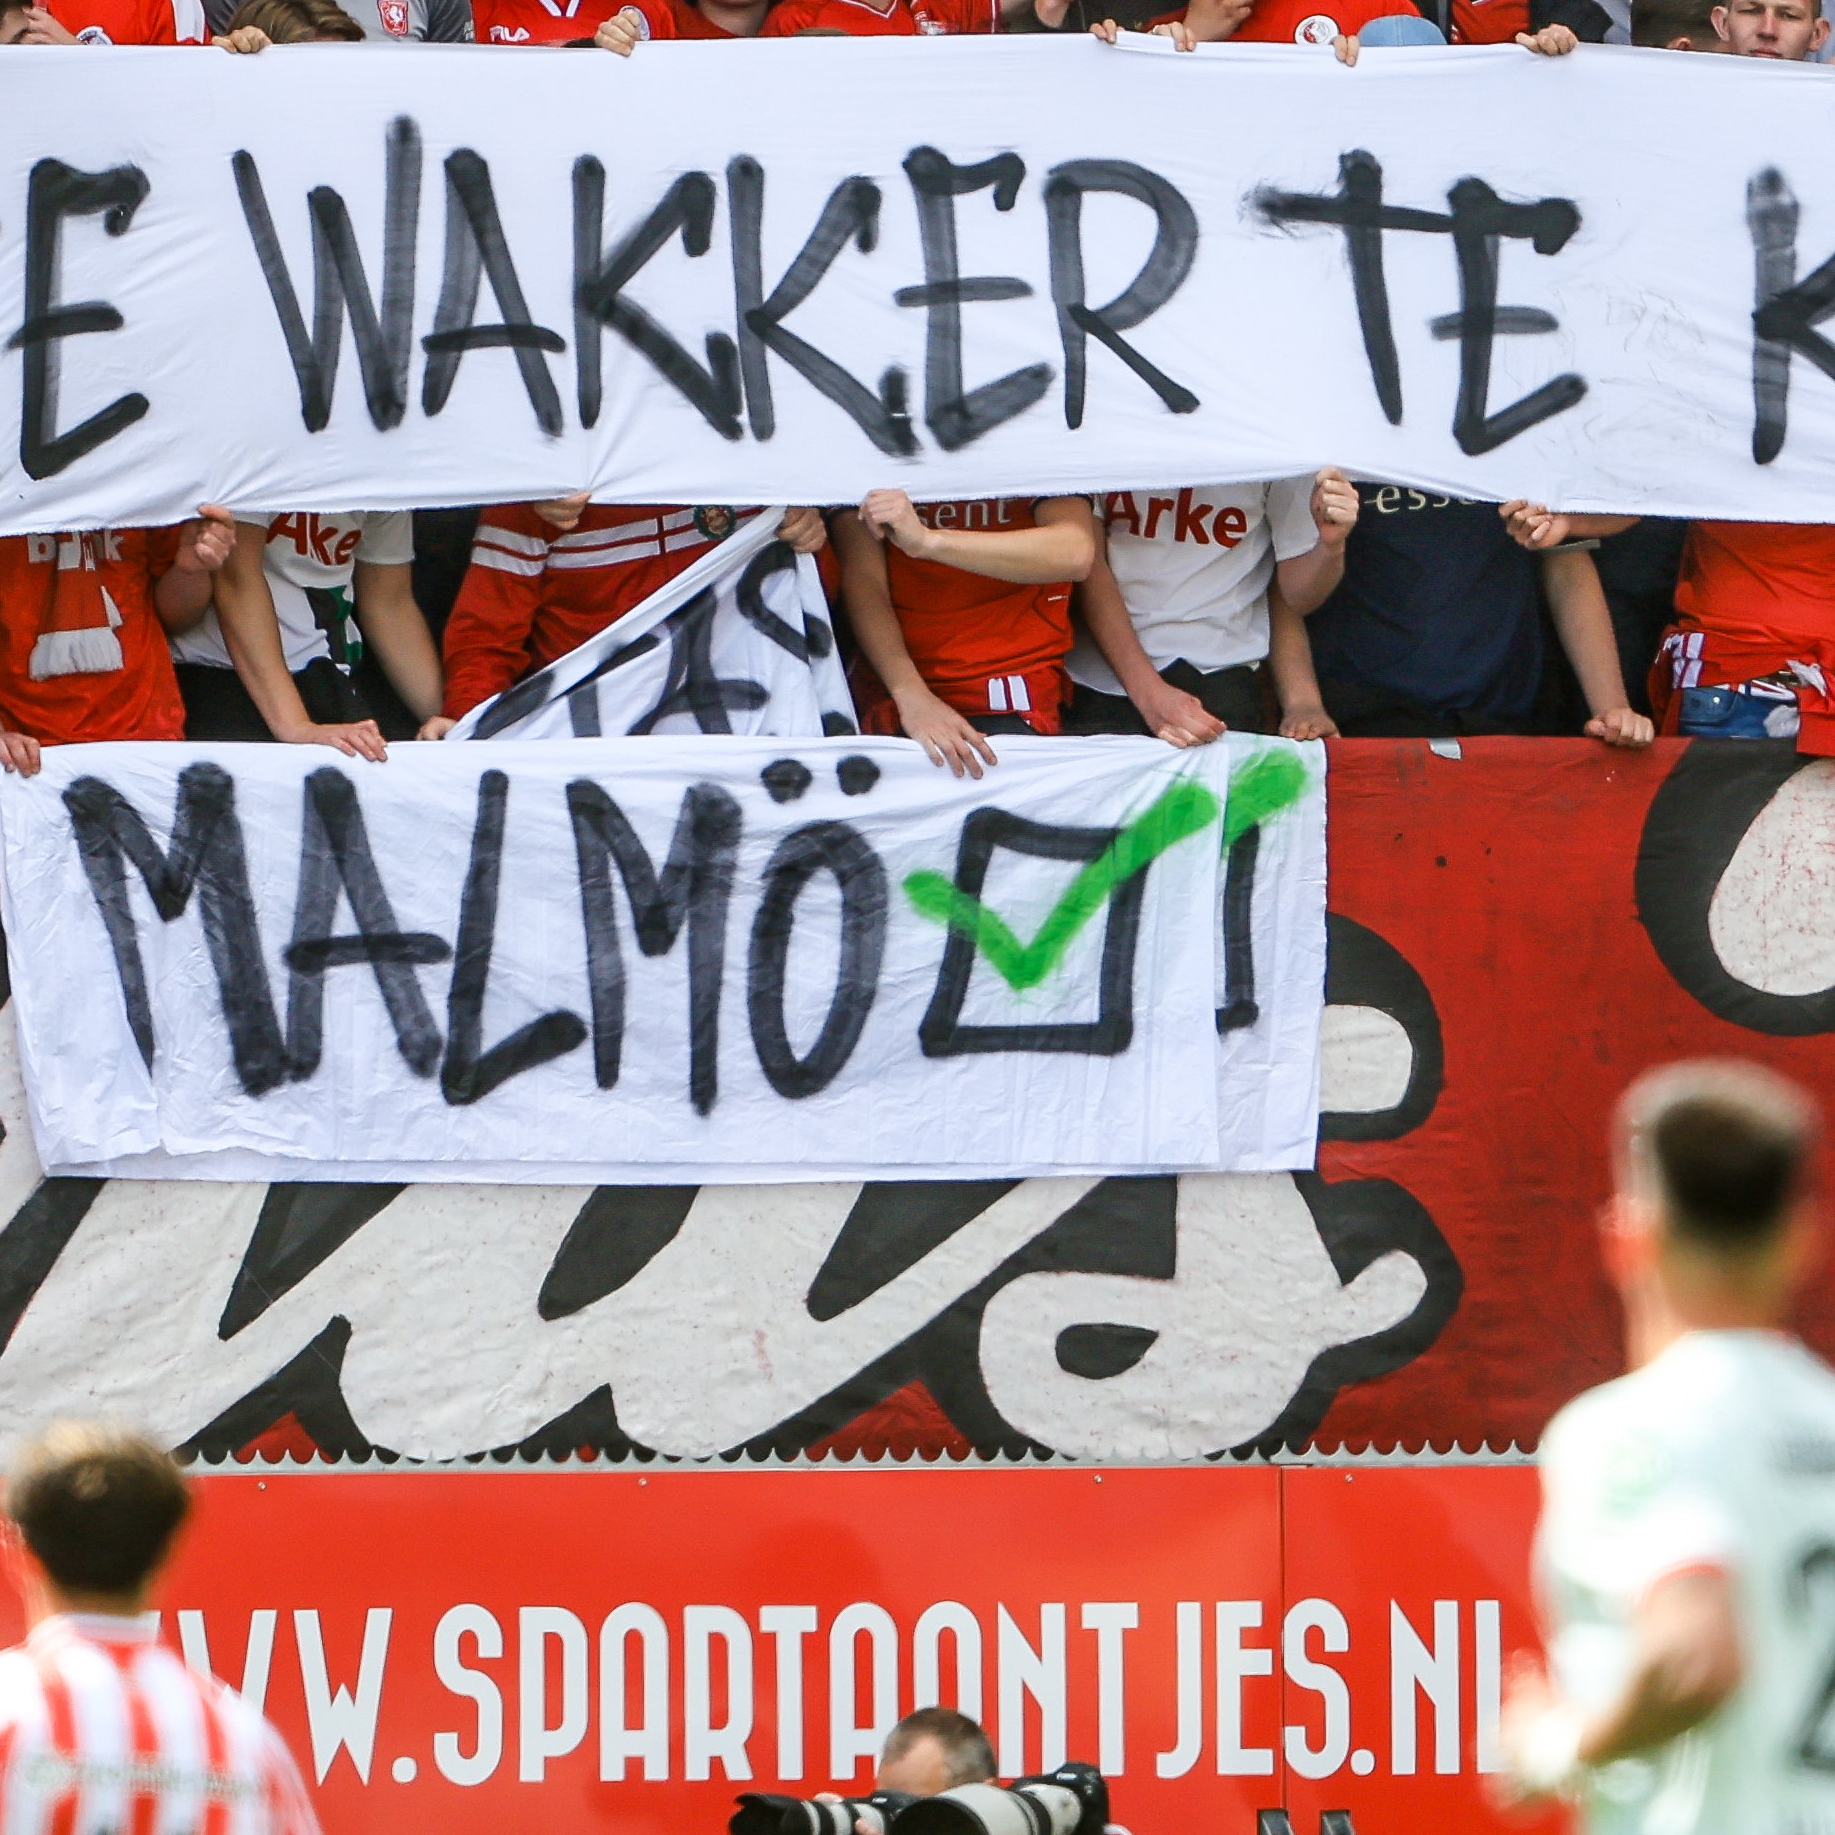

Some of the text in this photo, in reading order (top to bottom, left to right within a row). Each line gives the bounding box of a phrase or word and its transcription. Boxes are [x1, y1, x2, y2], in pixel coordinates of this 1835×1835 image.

[231, 115, 1201, 458] WAKKER
[1250, 150, 1587, 456] TE
[1103, 491, 1248, 549] Arke
[62, 755, 887, 1116] MALMÖ
[142, 1598, 1510, 1786] WW.SPARTAANTJES.NL
